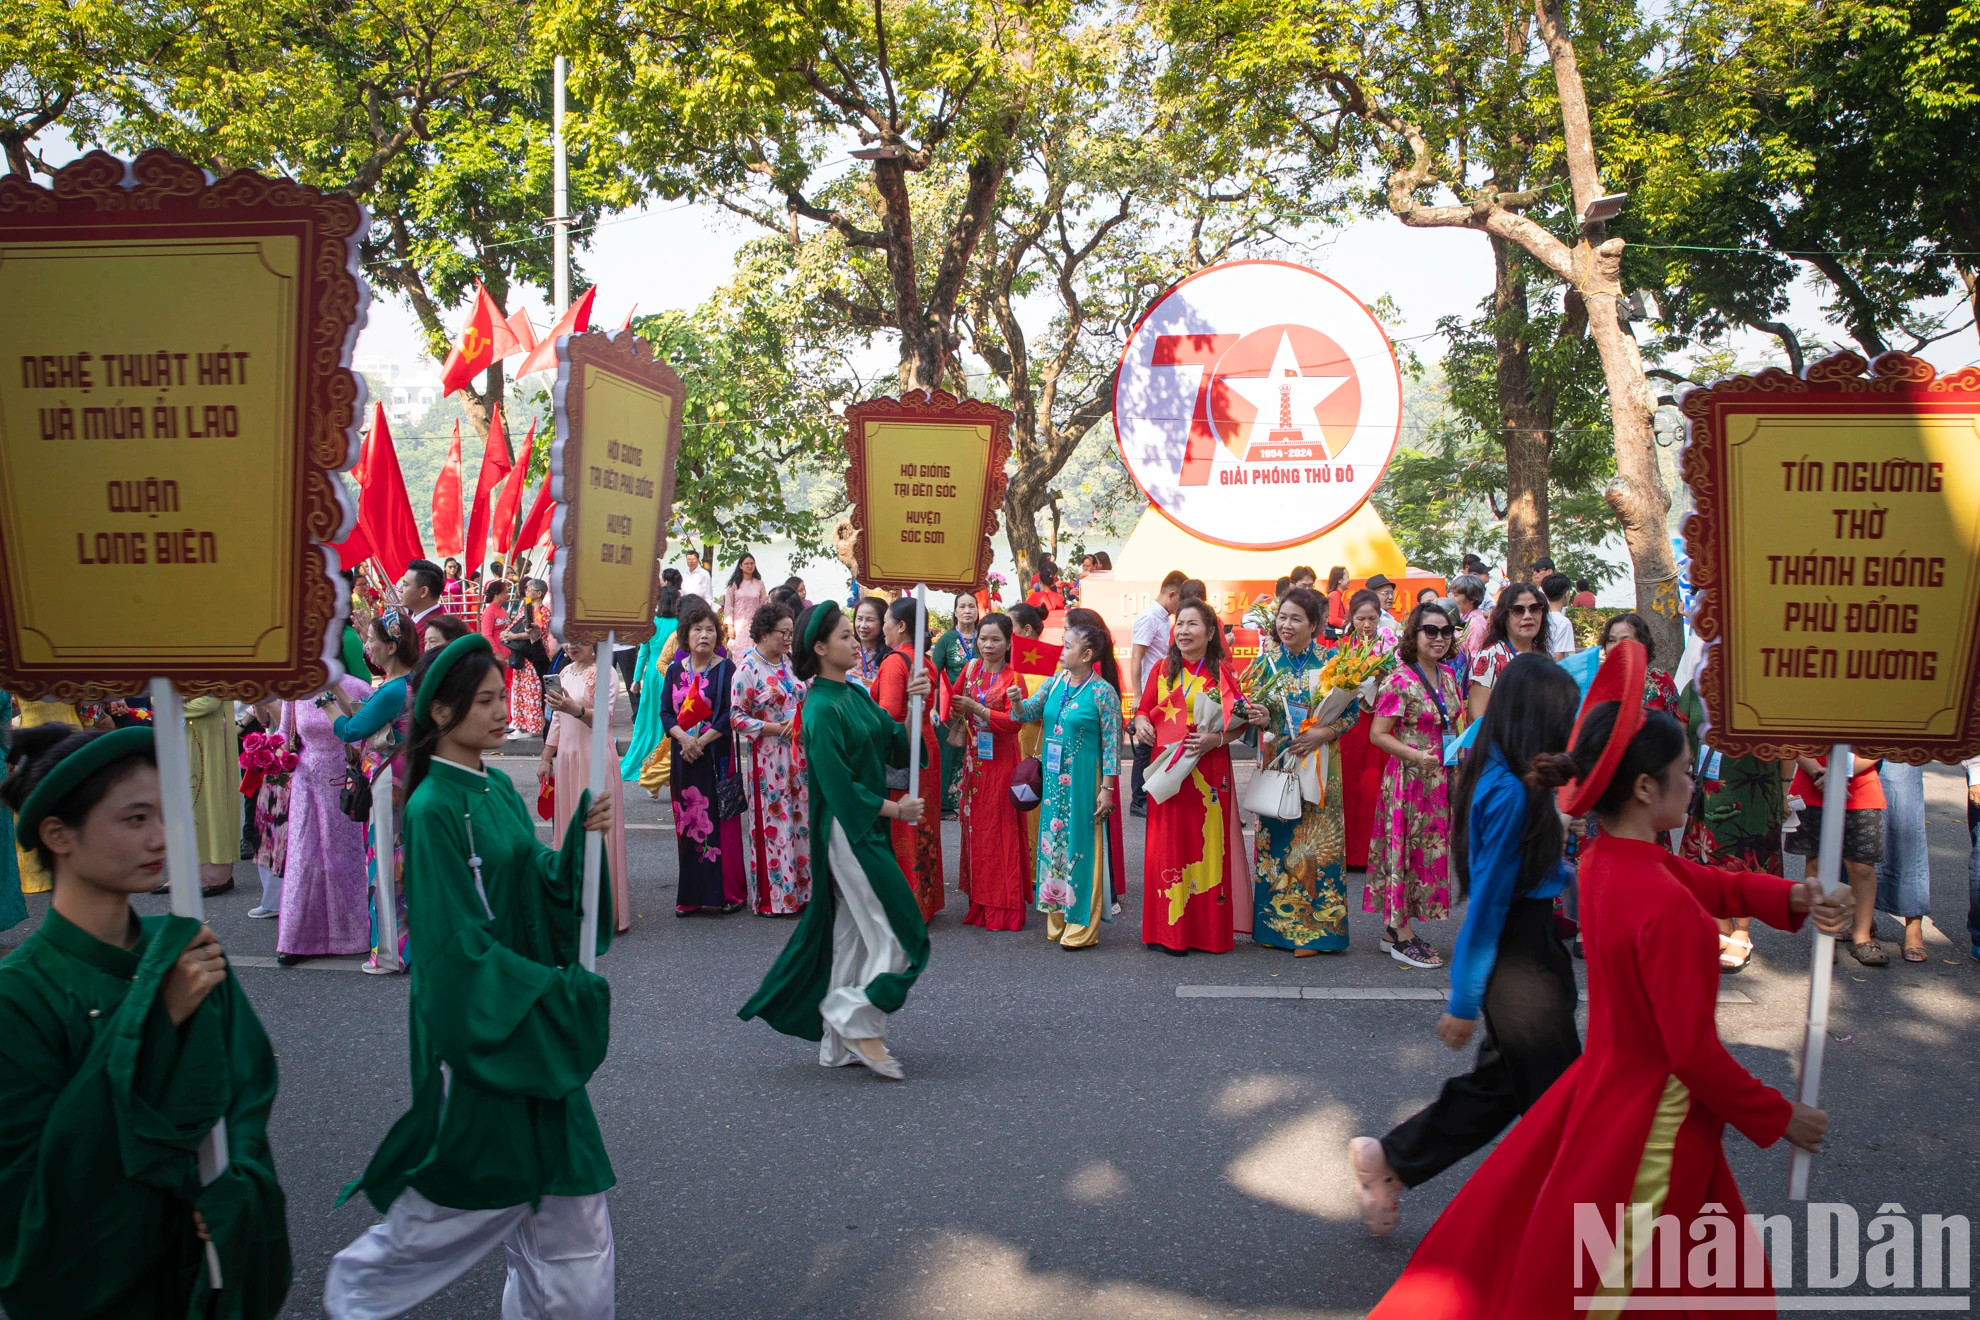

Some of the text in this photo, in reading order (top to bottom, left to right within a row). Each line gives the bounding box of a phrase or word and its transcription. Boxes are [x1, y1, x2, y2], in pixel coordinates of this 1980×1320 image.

[21, 343, 250, 393] NGHỆ THUẬT HÁT
[82, 399, 145, 440] MÚA
[186, 405, 239, 438] LAO
[900, 462, 950, 479] HỘI GIÓNG
[1220, 464, 1354, 485] GIẢI PHÓNG THỦ ĐÔ
[1781, 453, 1943, 492] TÍN NGƯỠNG
[107, 477, 180, 518] QUẬN
[894, 481, 957, 498] TẠI ĐỀN SÓC
[901, 527, 945, 544] SÓC SƠN
[906, 510, 941, 526] HUYỆN
[1832, 502, 1889, 539] THỜ
[77, 528, 217, 564] LONG BIÊN
[1767, 548, 1945, 587] THÁNH GIÓNG
[1784, 595, 1919, 634] PHÙ ĐỔNG
[1760, 645, 1838, 679] THIÊN
